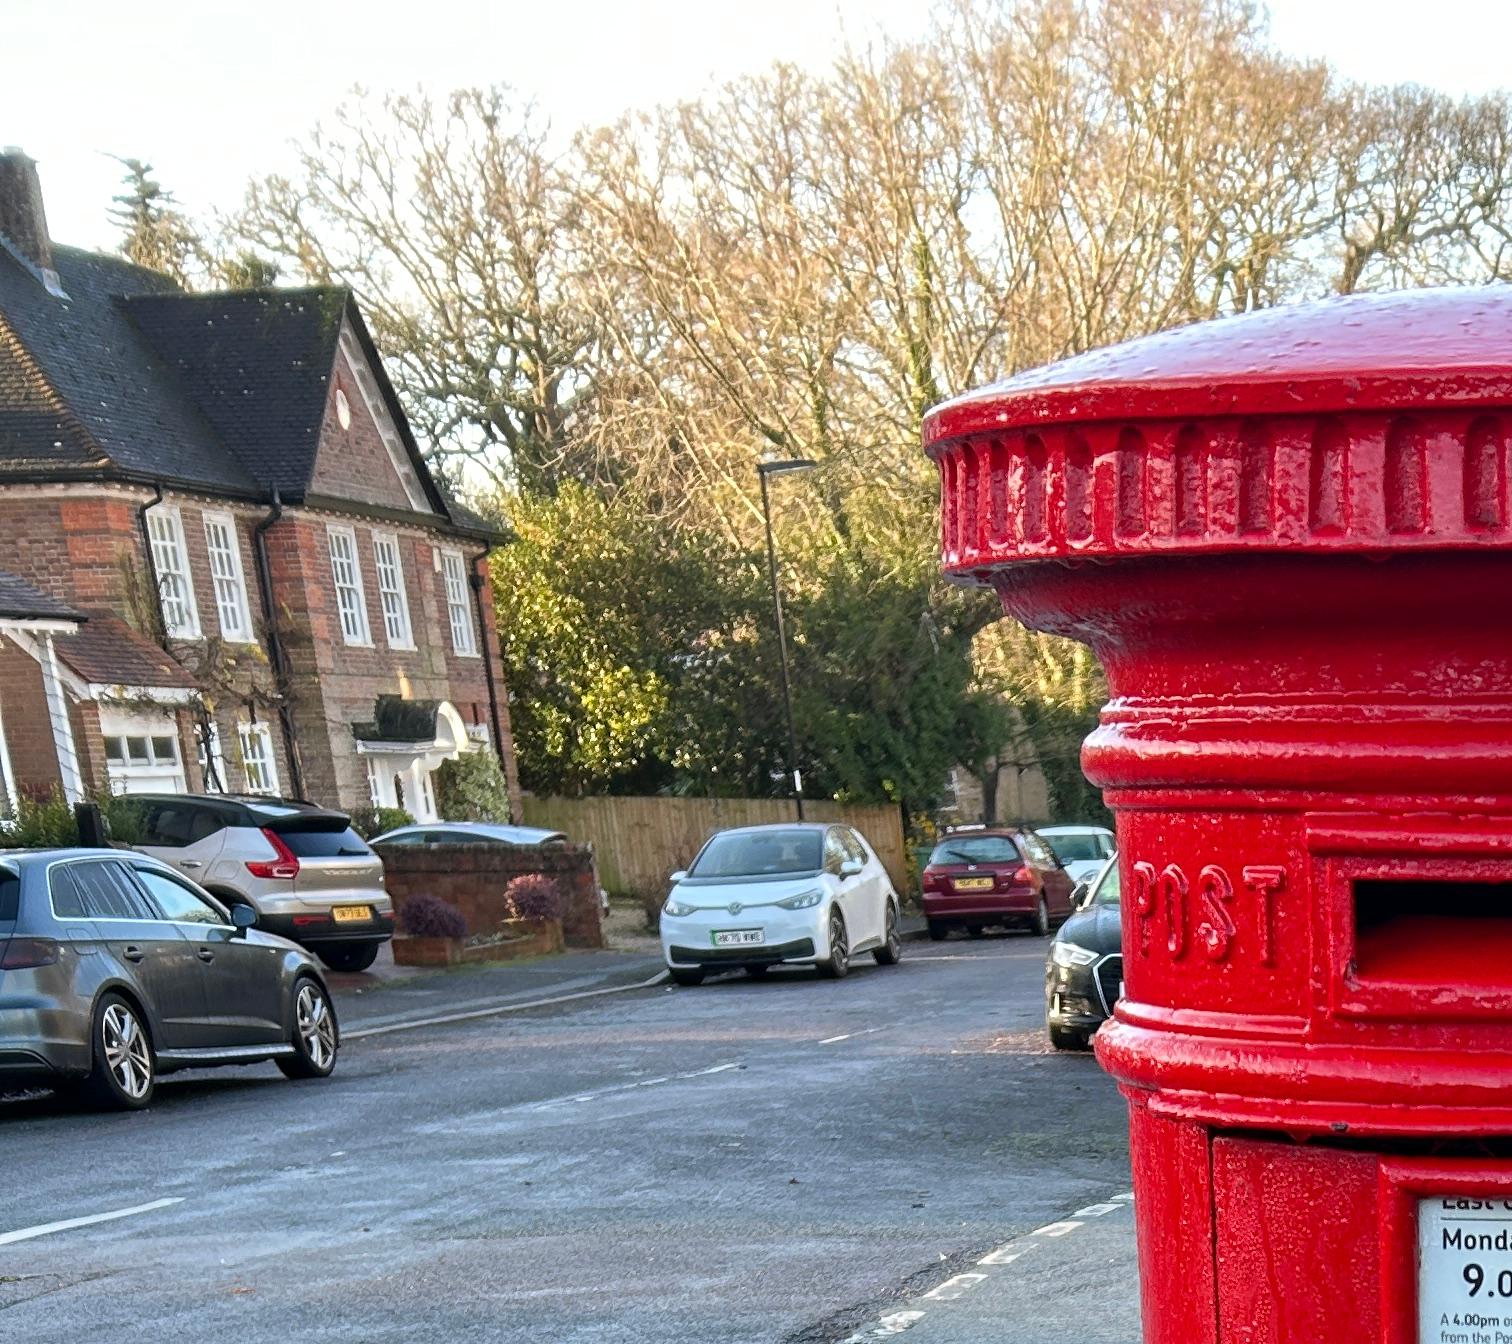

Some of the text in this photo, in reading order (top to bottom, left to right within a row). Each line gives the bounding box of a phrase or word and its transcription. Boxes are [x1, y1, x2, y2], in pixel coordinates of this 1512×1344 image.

[1133, 861, 1287, 968] POST
[1440, 1312, 1449, 1326] A
[1453, 1312, 1500, 1329] 4.00pm
[1440, 1331, 1468, 1344] from
[1472, 1332, 1491, 1344] the
